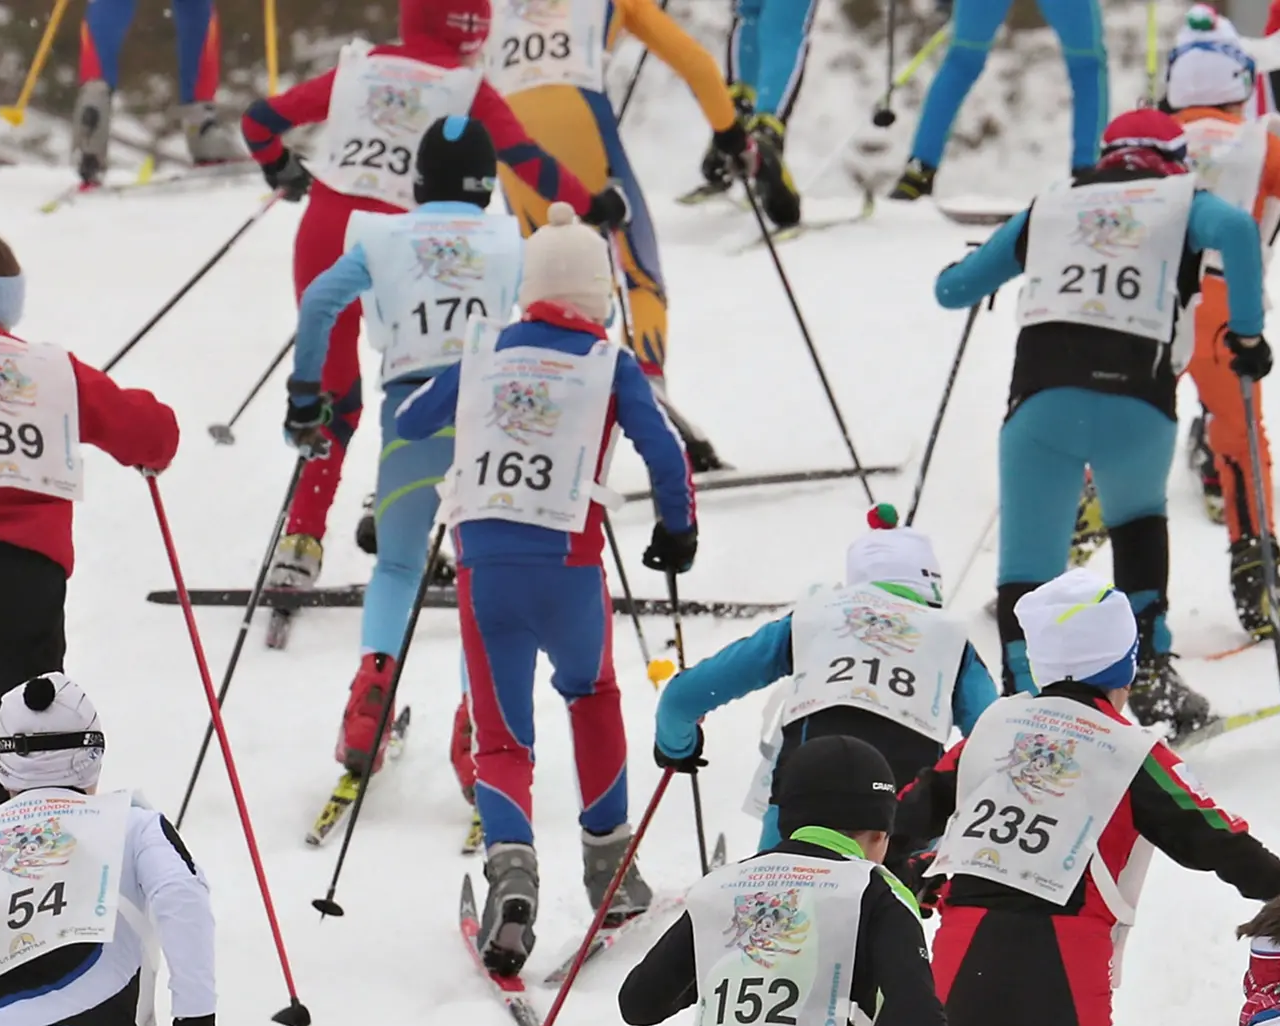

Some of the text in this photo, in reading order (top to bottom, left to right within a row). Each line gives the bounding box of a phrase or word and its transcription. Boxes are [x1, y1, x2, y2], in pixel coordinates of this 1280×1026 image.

[503, 33, 570, 67] 203
[340, 138, 411, 174] 223
[1060, 265, 1140, 300] 216
[475, 451, 554, 491] 163
[827, 657, 915, 697] 218
[963, 799, 1058, 854] 235
[715, 978, 799, 1025] 152
